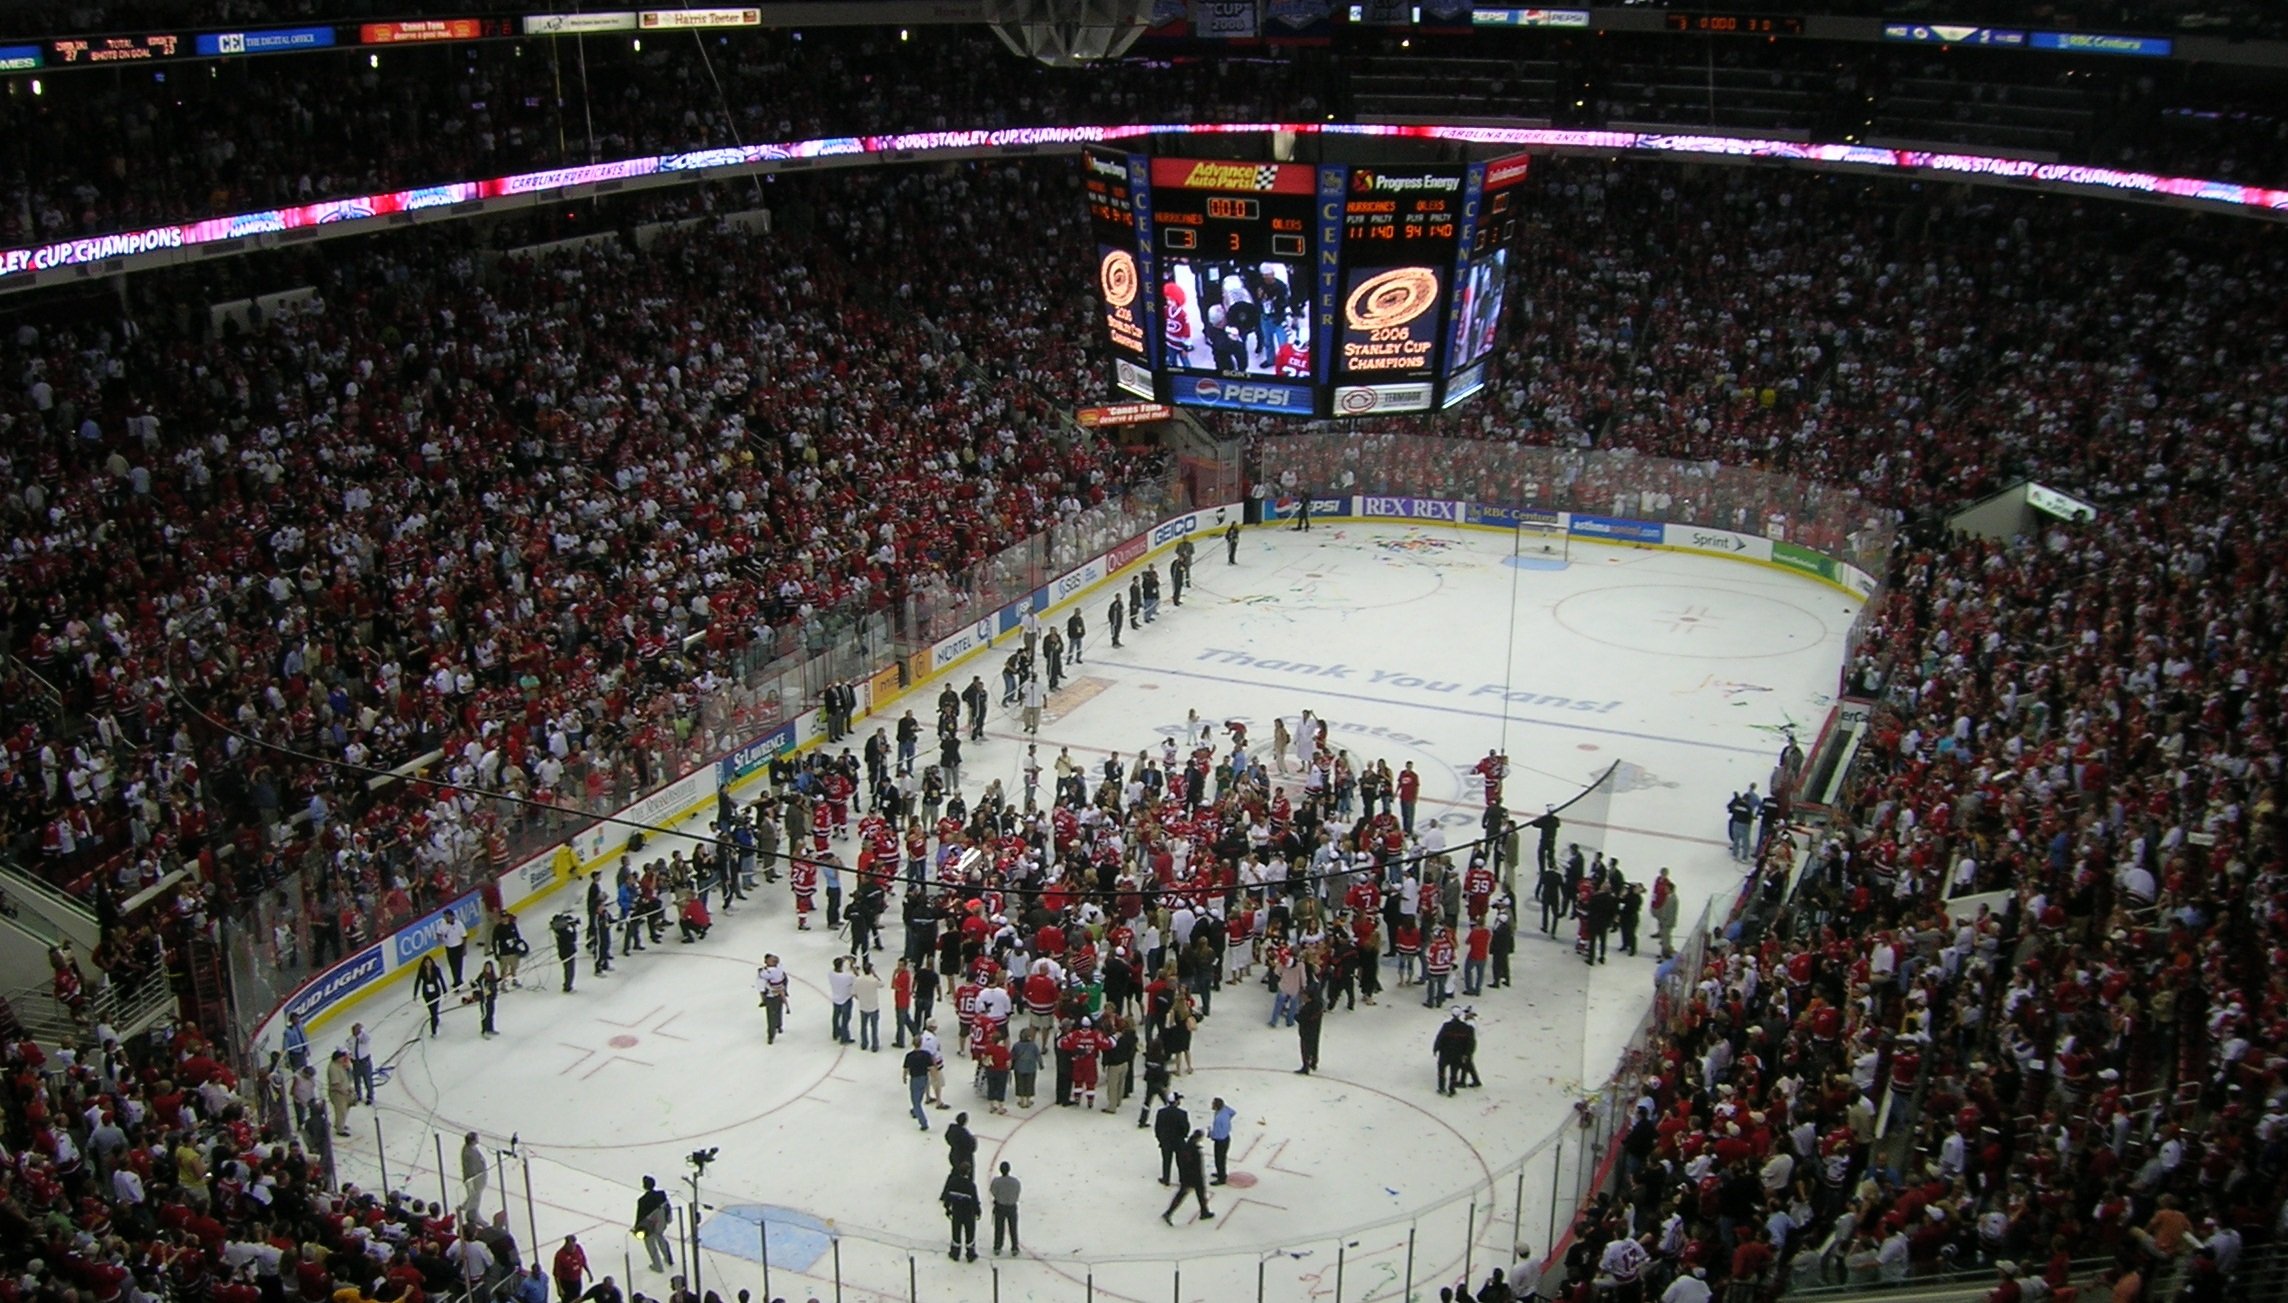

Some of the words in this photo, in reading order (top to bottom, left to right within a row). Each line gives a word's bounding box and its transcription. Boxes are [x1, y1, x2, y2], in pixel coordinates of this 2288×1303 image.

[675, 13, 706, 25] Harris
[708, 12, 739, 24] Teeter
[106, 39, 133, 49] TOTAL
[219, 34, 245, 53] CEI
[260, 35, 290, 46] DIGITAL
[896, 134, 930, 150] 2006
[930, 131, 989, 149] STANLEY
[990, 130, 1018, 145] CUP
[1018, 126, 1104, 144] CHAMPIONS
[1440, 128, 1503, 143] CAROLINA
[1503, 131, 1588, 145] HURRICANES
[511, 172, 561, 191] CAROLINA
[562, 163, 625, 185] HURRICANES
[1192, 161, 1252, 178] Advance
[1970, 157, 2037, 177] STANLEY
[2037, 164, 2069, 180] CUP
[2069, 165, 2159, 192] CHAMPIONS
[1184, 176, 1215, 187] Auto
[1216, 176, 1251, 189] Parts
[1375, 175, 1423, 192] Progress
[1423, 174, 1460, 191] Energy
[1183, 231, 1194, 247] 3
[1405, 225, 1422, 238] 94
[33, 245, 73, 272] CUP
[74, 227, 183, 265] CHAMPIONS
[1230, 233, 1240, 250] 3
[1135, 193, 1156, 313] CENTER
[1451, 201, 1477, 321] CENTER
[1322, 202, 1339, 325] CENTER
[1370, 328, 1410, 341] 2006
[1344, 342, 1401, 356] STANLEY
[1403, 340, 1432, 354] CUP
[1347, 356, 1425, 370] CHAMPIONS
[1224, 384, 1290, 406] PEPSI
[1292, 500, 1340, 513] PPSI
[1366, 498, 1405, 516] REX
[1413, 500, 1453, 519] REX
[1483, 507, 1510, 520] RBC
[1511, 509, 1558, 524] Centura
[1154, 515, 1197, 546] GEICO
[1692, 532, 1730, 550] Sprint
[937, 635, 972, 665] NORTEL
[1196, 646, 1359, 680] Thank
[1364, 668, 1462, 695] You
[1465, 682, 1623, 714] Fans!
[1472, 880, 1489, 893] 39
[324, 957, 378, 997] LIGHT
[960, 996, 976, 1013] 16
